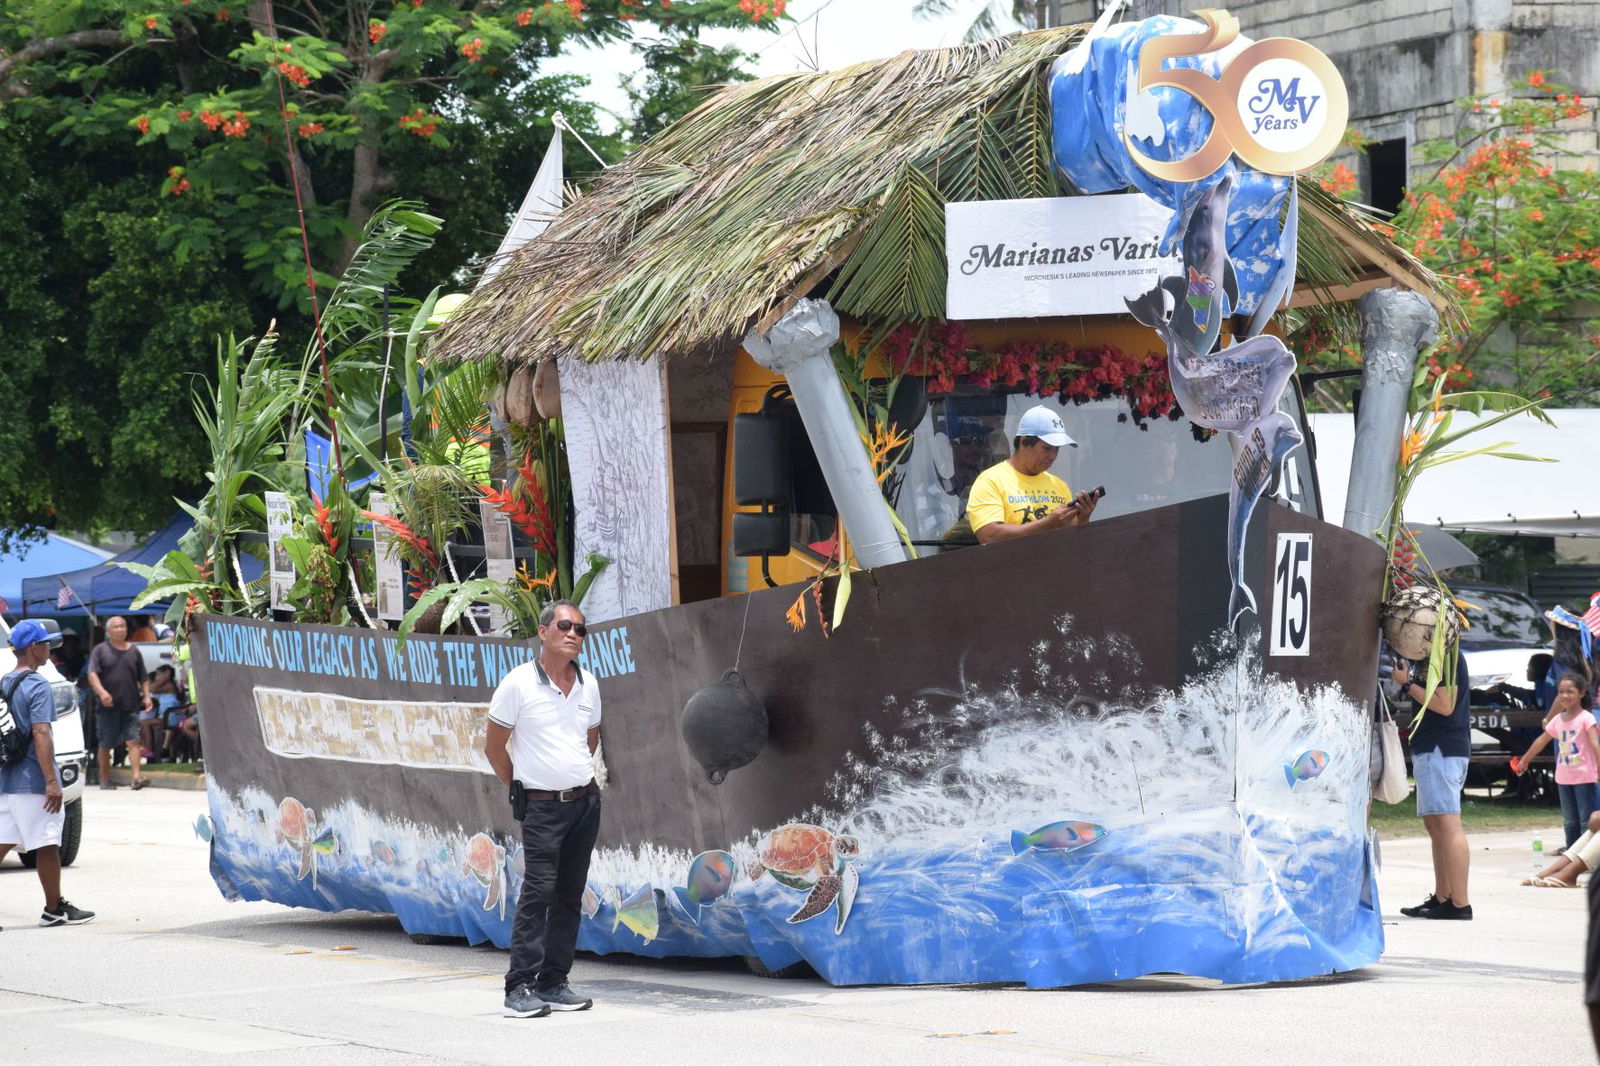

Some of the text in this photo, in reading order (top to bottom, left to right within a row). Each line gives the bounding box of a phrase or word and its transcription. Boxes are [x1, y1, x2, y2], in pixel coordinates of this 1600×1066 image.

[1122, 8, 1348, 182] 50
[1248, 77, 1320, 124] MV
[1252, 114, 1298, 134] years
[960, 236, 1184, 275] Marianas Varit
[1024, 273, 1065, 281] MICRONESIA'S
[1066, 271, 1091, 279] LEADING
[1092, 269, 1126, 278] NEWSPAPER
[1008, 494, 1049, 504] DUATHLON
[1277, 540, 1309, 649] 15
[206, 621, 274, 669] HONORING
[272, 629, 306, 672] OUR
[307, 631, 356, 677] LEGACY
[360, 636, 378, 680] AS
[382, 637, 407, 681] WE
[406, 639, 442, 685] RIDE
[443, 641, 478, 687] THE
[578, 626, 636, 679] HANGE
